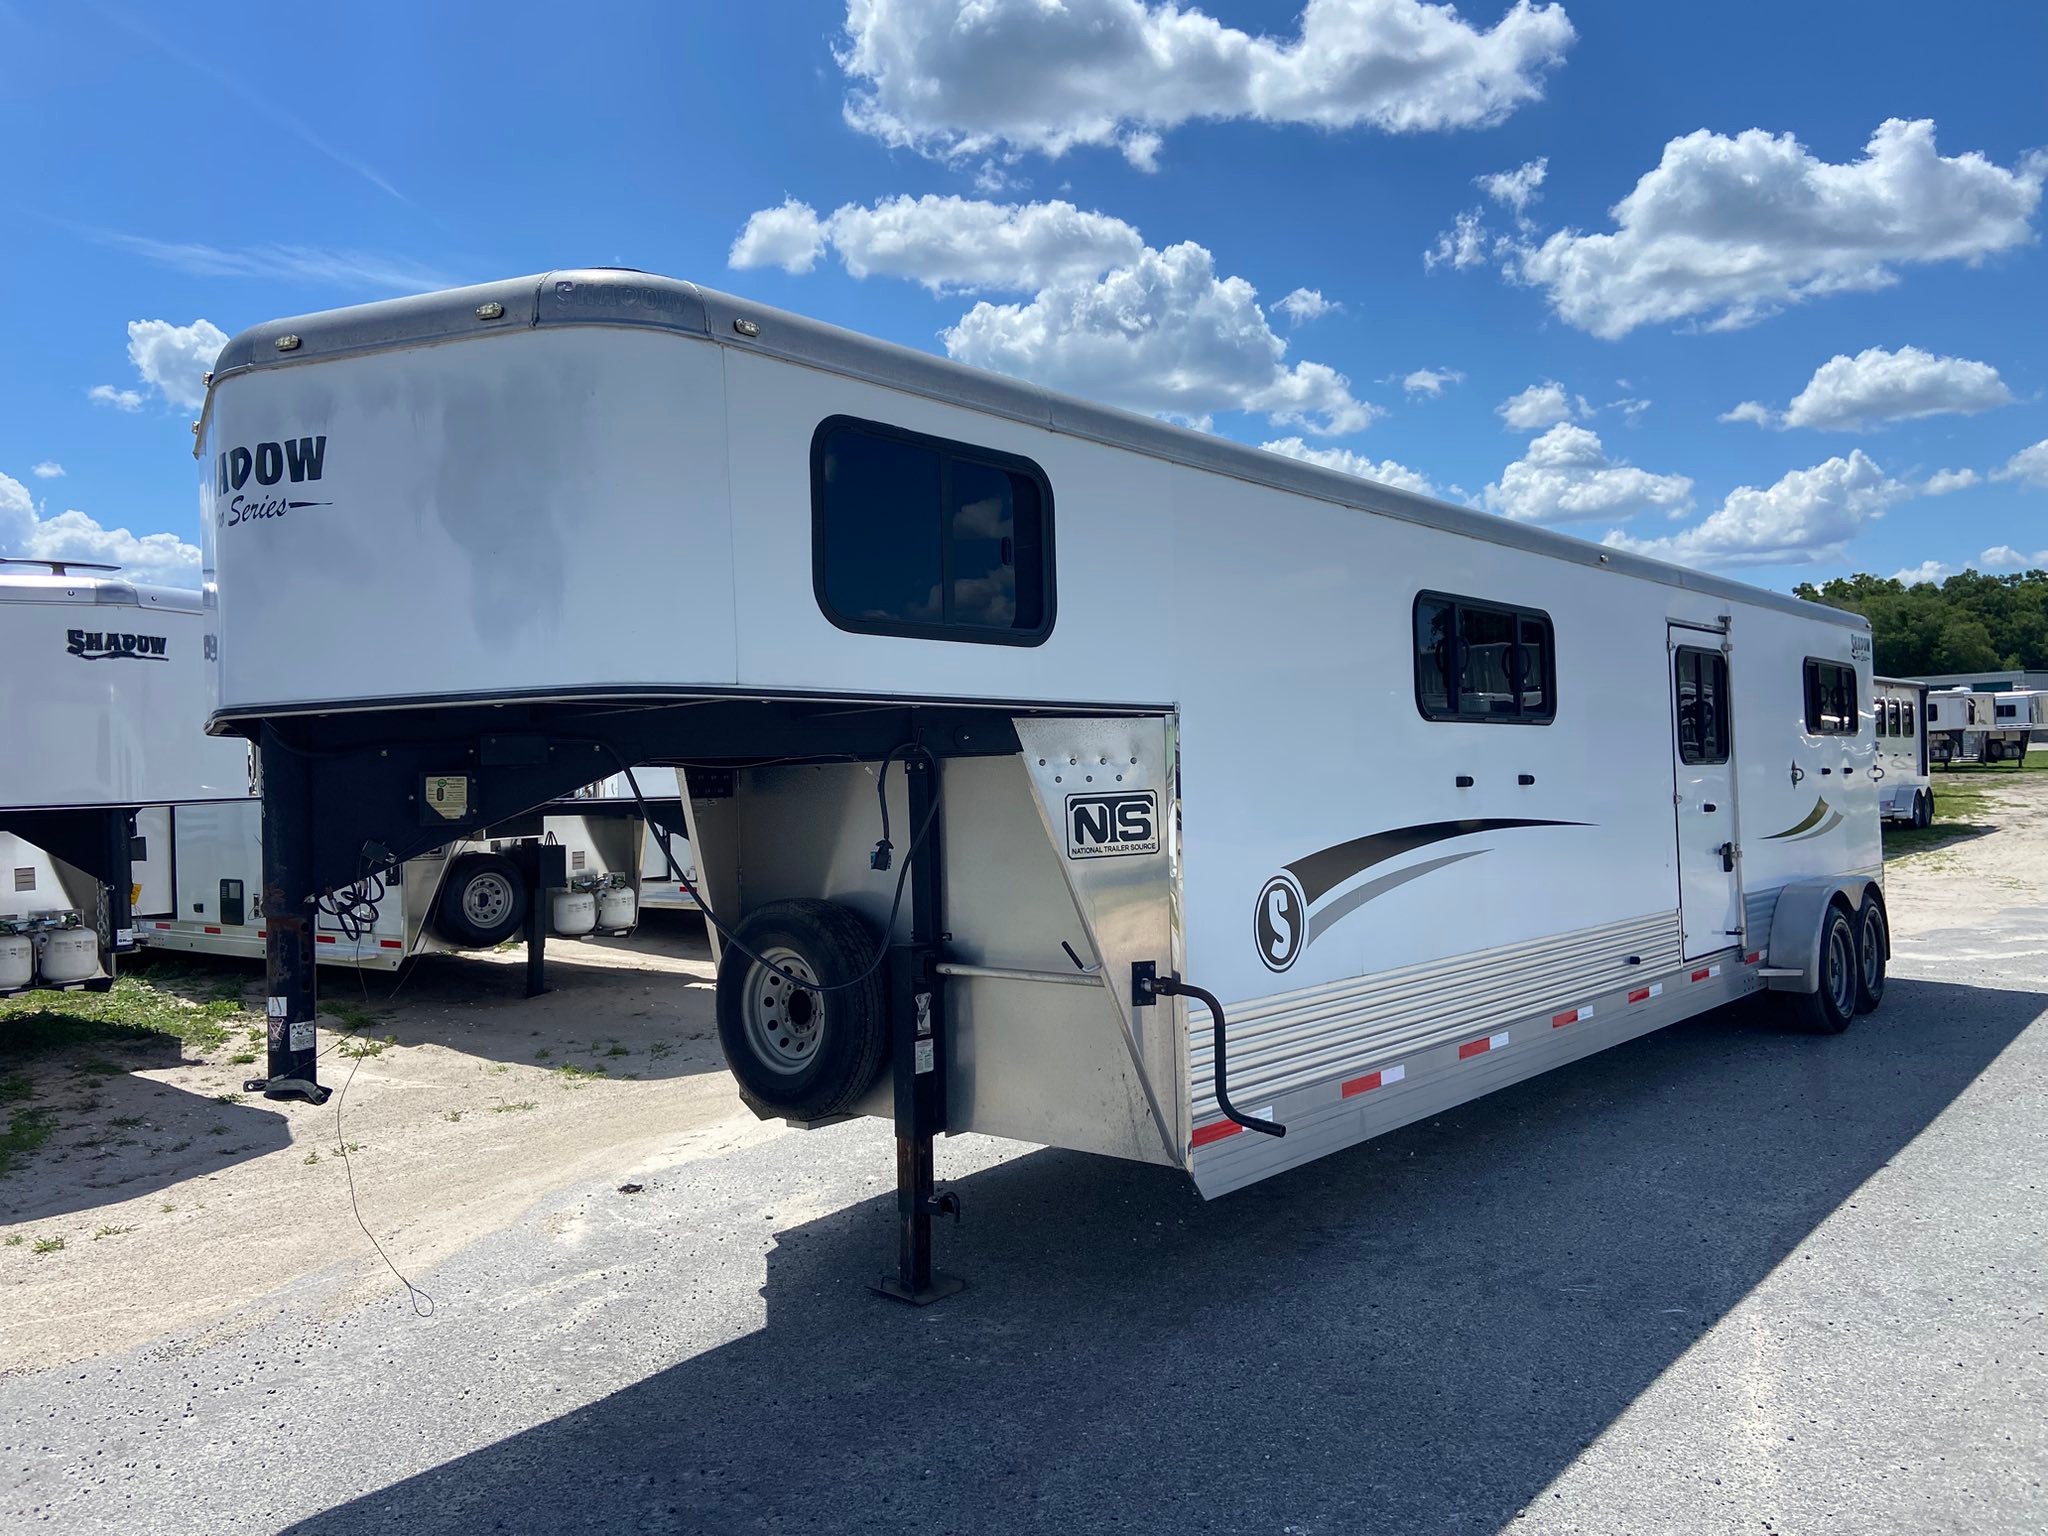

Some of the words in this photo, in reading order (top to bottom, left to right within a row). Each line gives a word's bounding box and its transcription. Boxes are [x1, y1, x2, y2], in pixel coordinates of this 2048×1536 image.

[215, 436, 327, 497] ADOW
[228, 494, 287, 526] Series
[67, 629, 167, 655] SHADOW
[1070, 795, 1153, 845] NTS
[1071, 846, 1103, 855] NATIONAL
[1104, 843, 1130, 853] TRAILER
[1130, 842, 1156, 850] SOURCE
